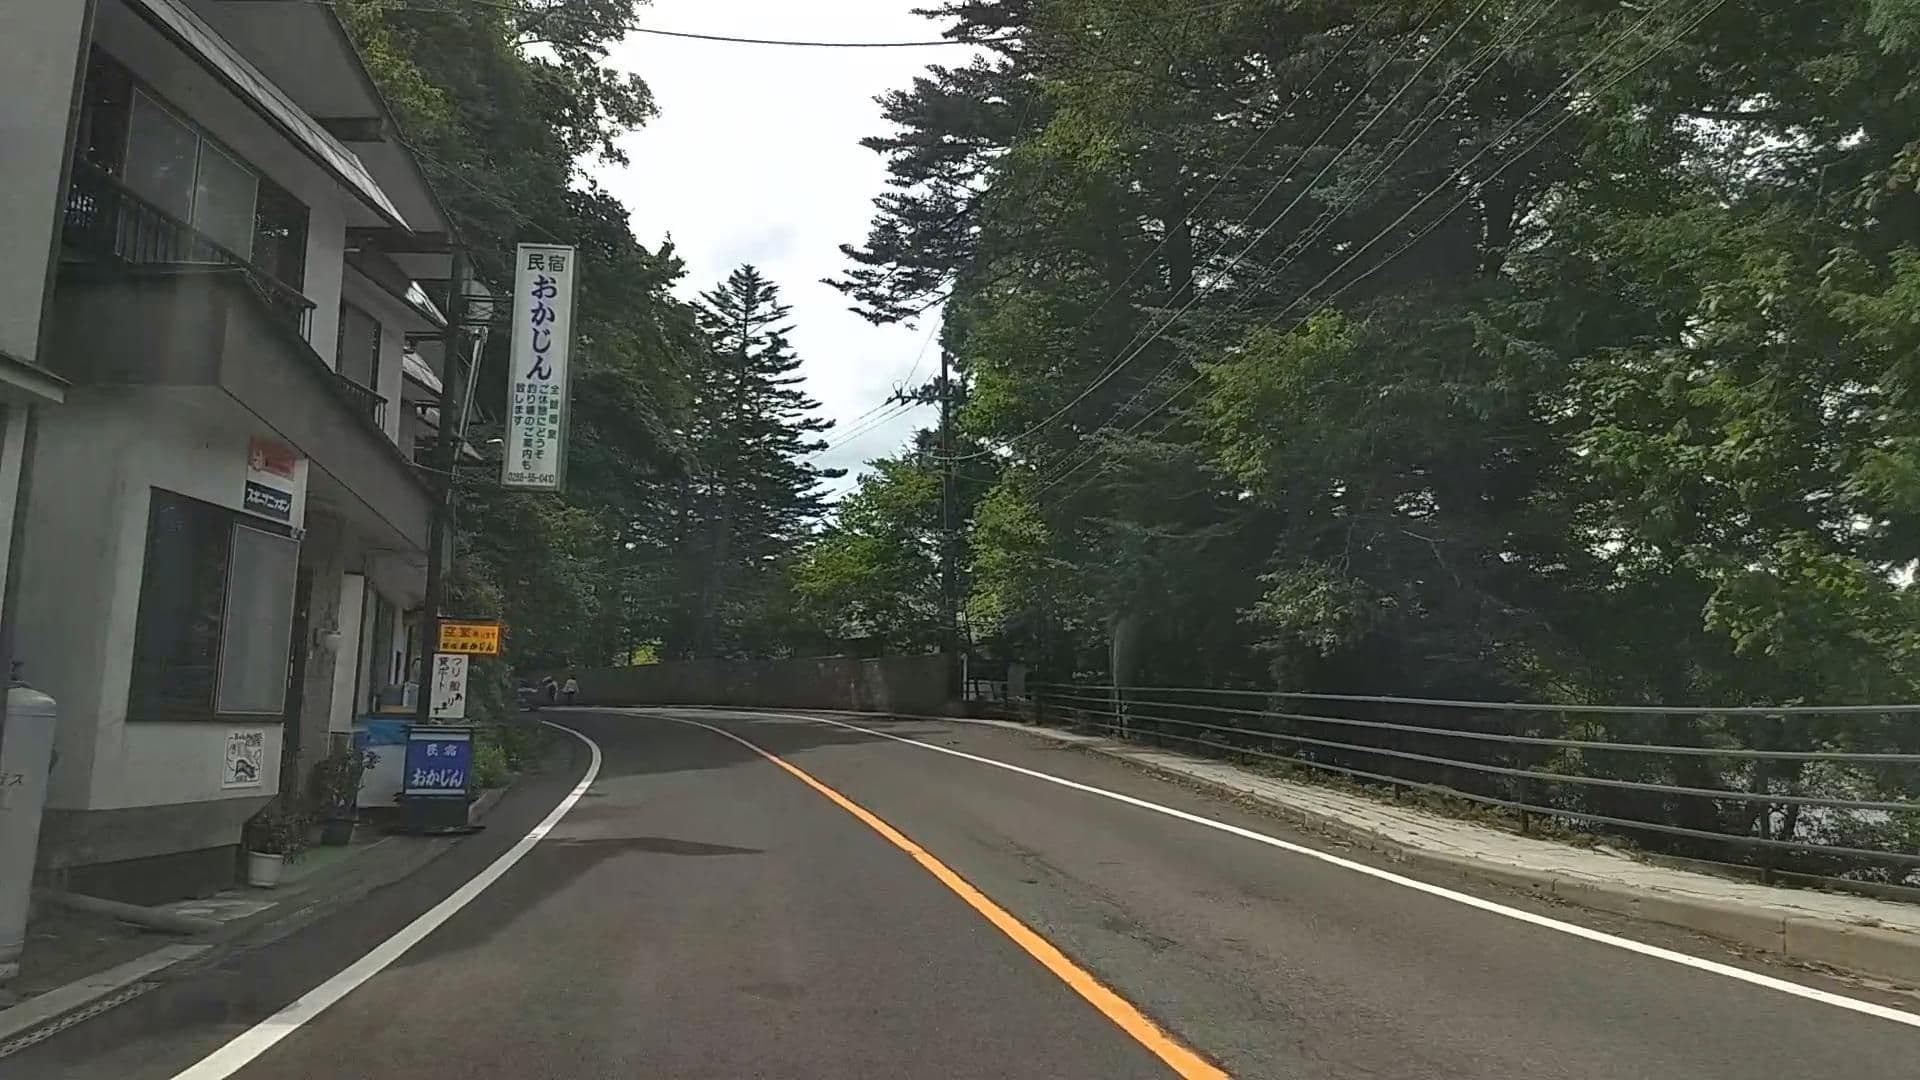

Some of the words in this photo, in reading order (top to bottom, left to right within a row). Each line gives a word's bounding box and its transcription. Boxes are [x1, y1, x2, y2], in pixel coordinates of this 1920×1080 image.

[527, 254, 565, 272] 民宿
[527, 274, 557, 380] おかじん
[514, 382, 526, 426] 致します
[426, 743, 457, 757] 民宿
[411, 767, 464, 788] おかじん
